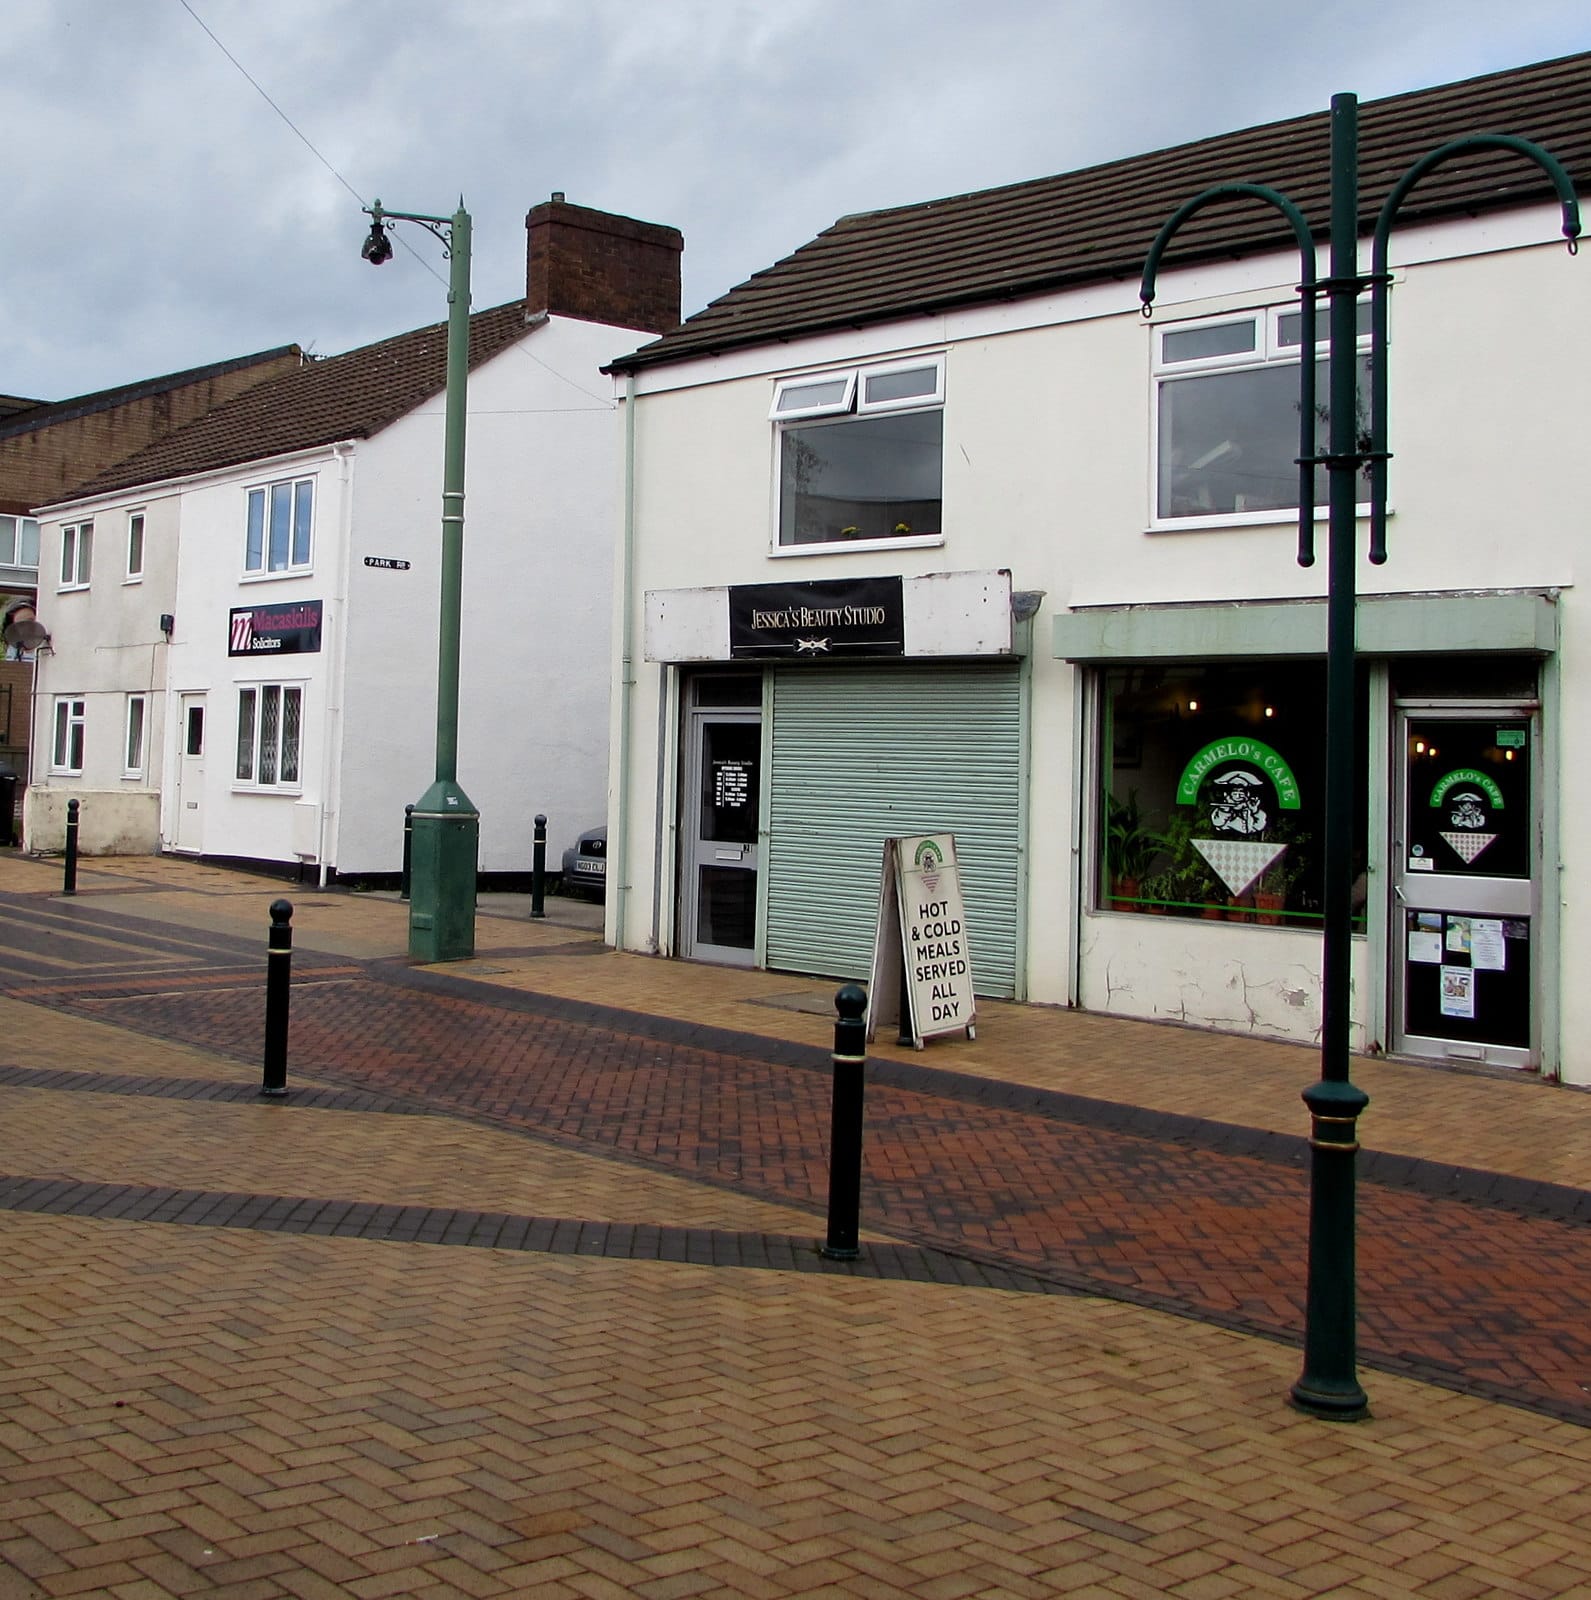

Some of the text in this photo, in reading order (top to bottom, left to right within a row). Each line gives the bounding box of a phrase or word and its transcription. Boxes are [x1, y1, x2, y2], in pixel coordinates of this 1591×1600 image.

[369, 558, 392, 568] PARK
[253, 606, 318, 631] Macaskills
[752, 605, 885, 630] JESSICA'S BEAUTY STUDIO
[252, 636, 282, 650] Solicitors
[1264, 756, 1296, 801] CAFE
[1482, 779, 1502, 805] CAFE
[919, 901, 948, 919] HOT
[911, 920, 961, 941] & COLD
[917, 940, 960, 961] MEALS
[916, 959, 966, 982] SERVED
[931, 982, 957, 1000] ALL
[932, 1002, 960, 1021] DAY
